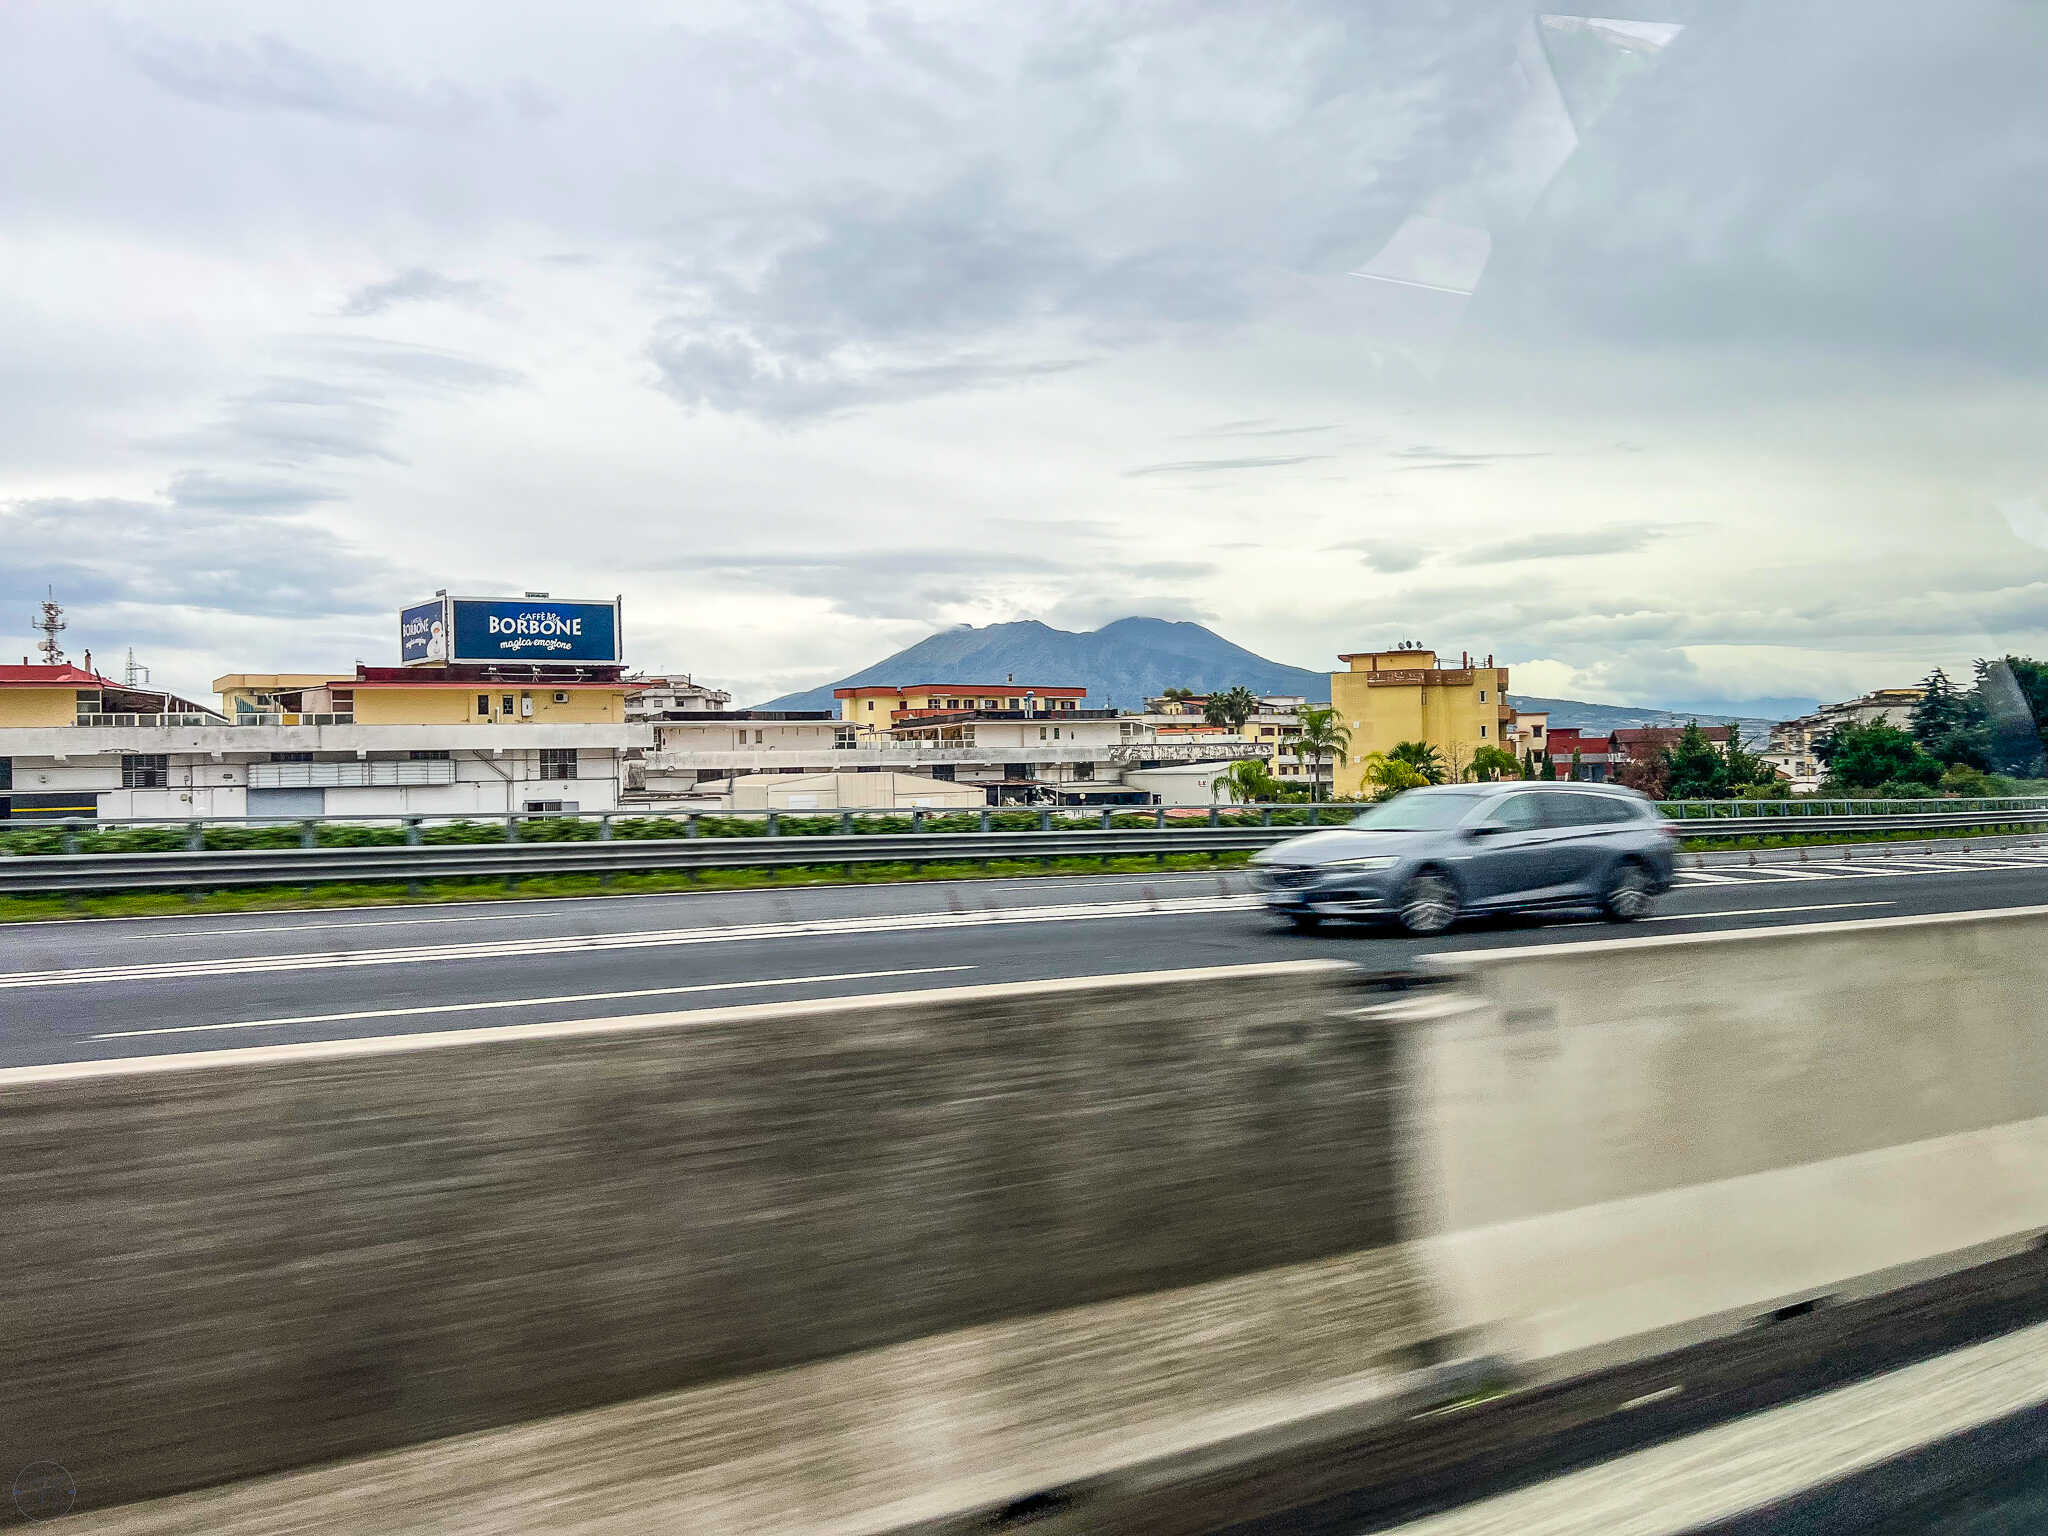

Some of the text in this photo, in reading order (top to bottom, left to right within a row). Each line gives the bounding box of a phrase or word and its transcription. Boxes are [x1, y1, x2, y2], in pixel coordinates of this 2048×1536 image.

[519, 612, 546, 621] CAFFÈ
[489, 616, 582, 636] BORBONE
[500, 637, 572, 651] magica emozione
